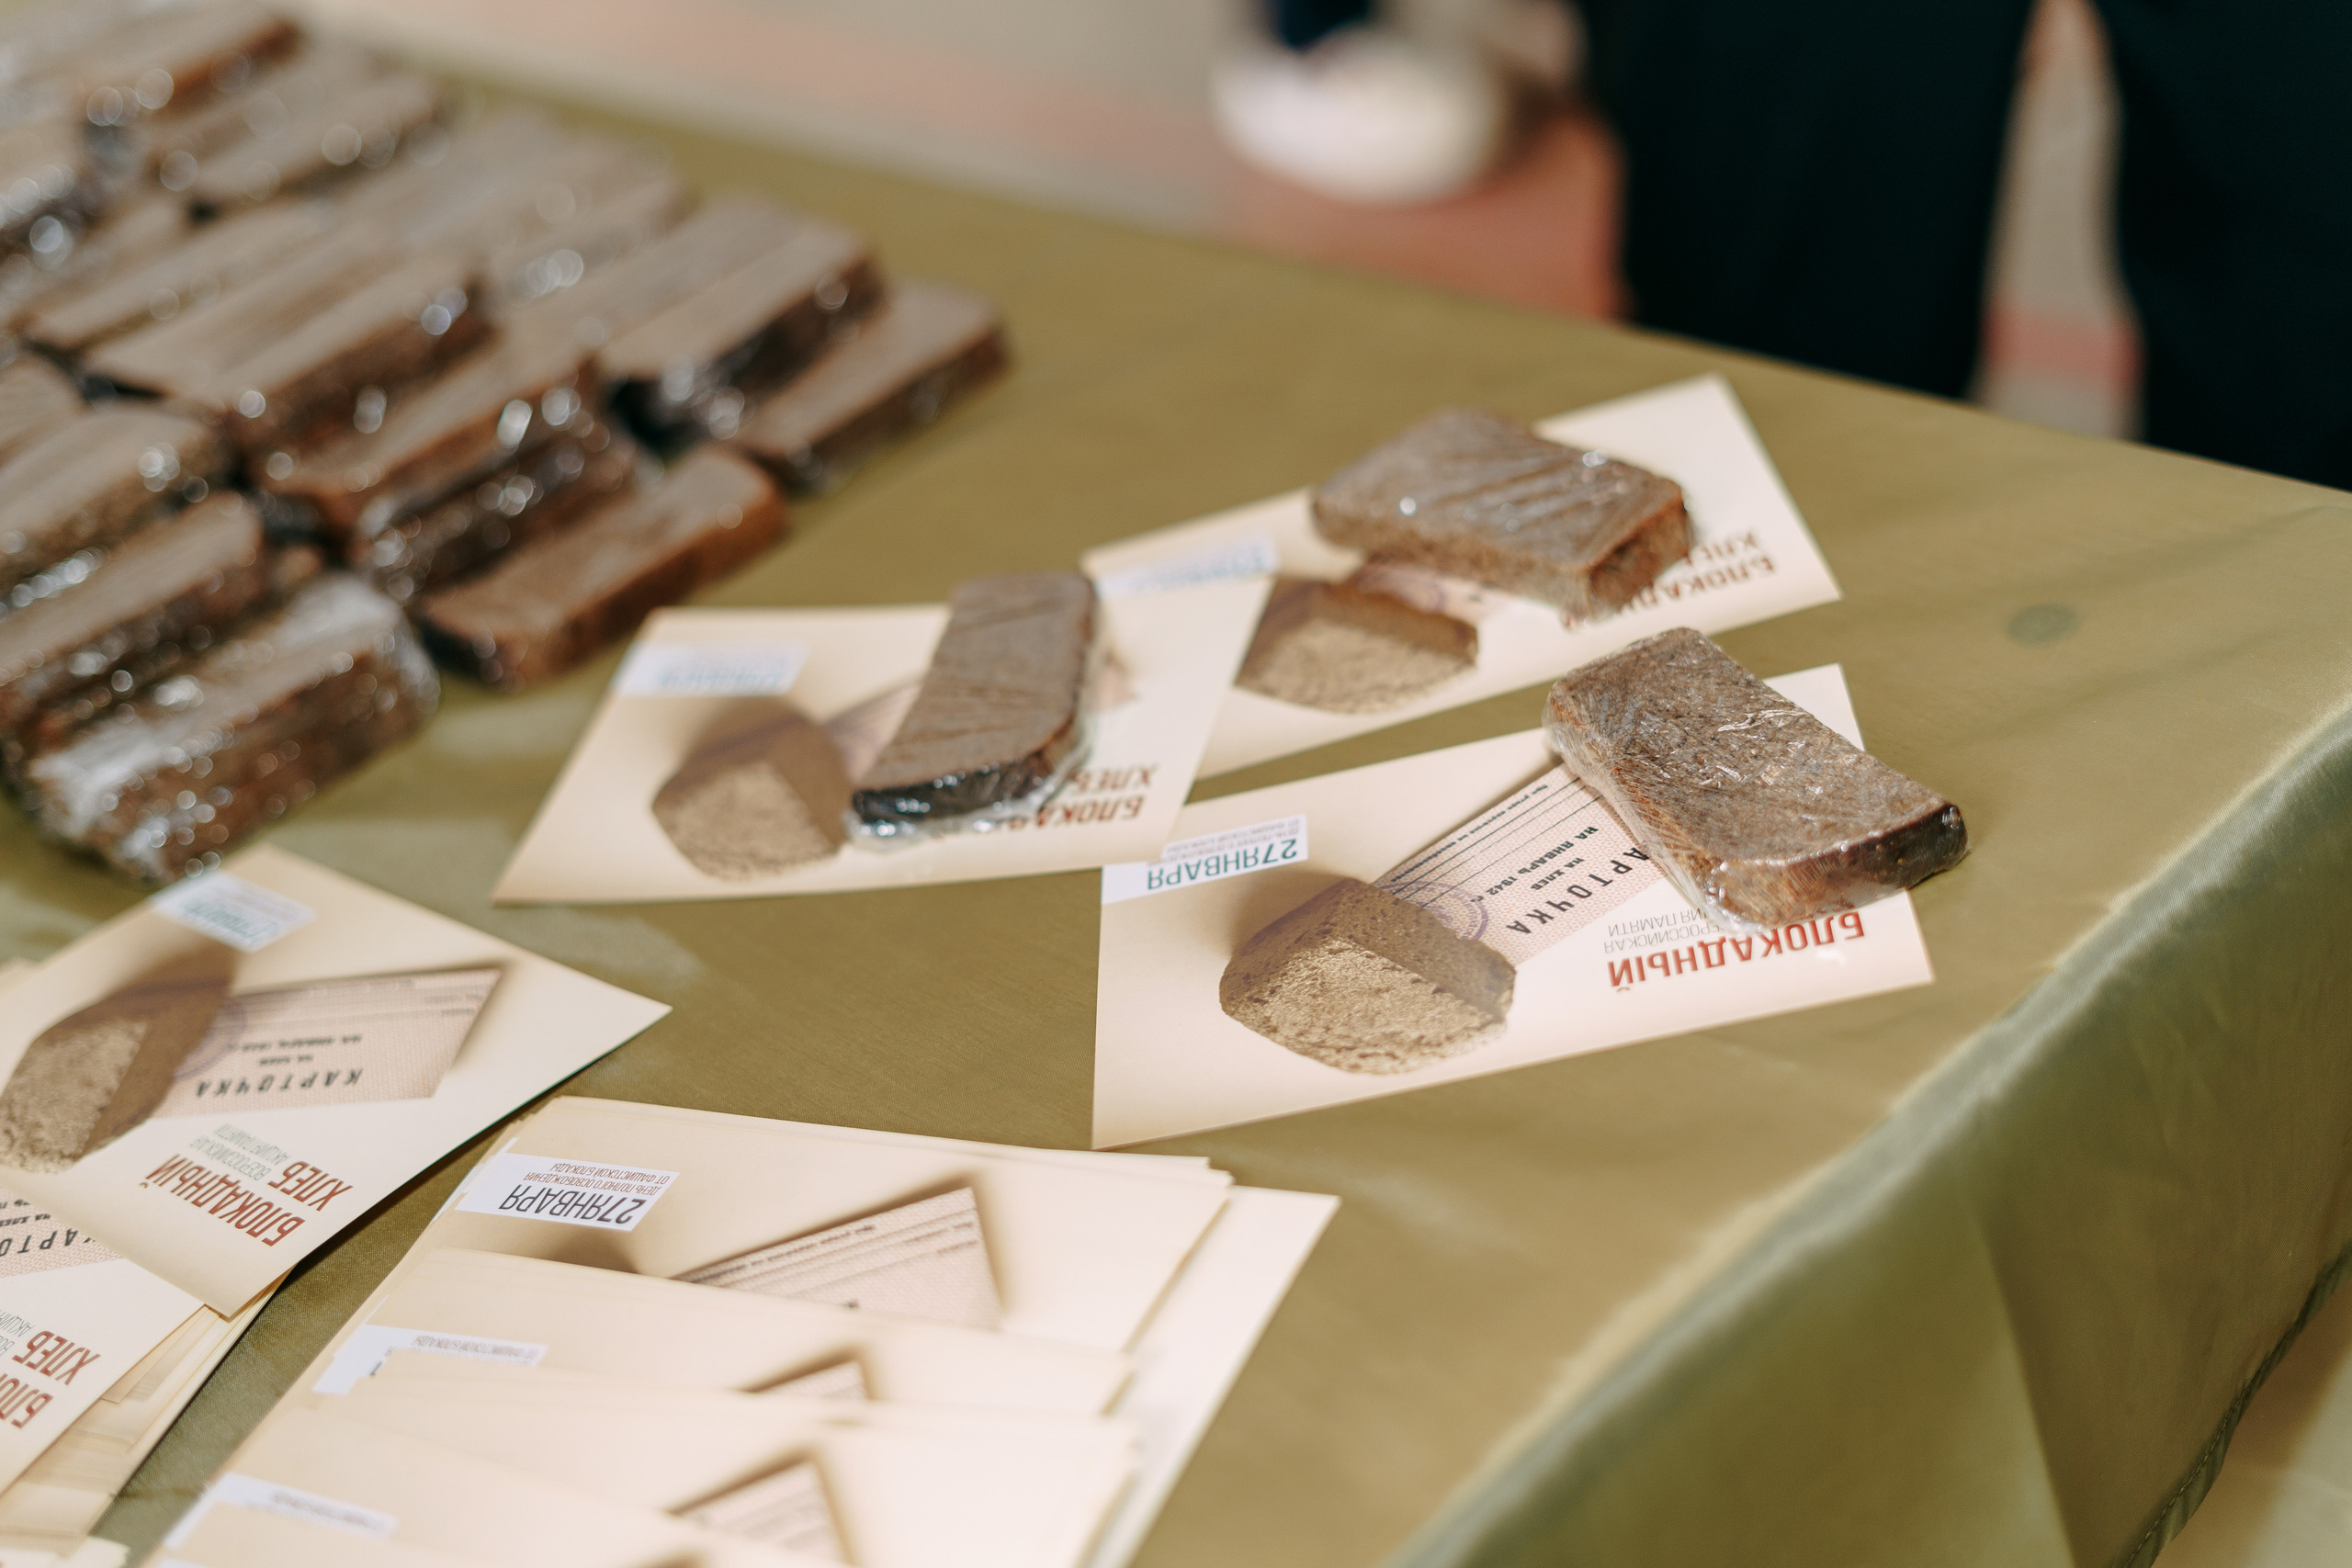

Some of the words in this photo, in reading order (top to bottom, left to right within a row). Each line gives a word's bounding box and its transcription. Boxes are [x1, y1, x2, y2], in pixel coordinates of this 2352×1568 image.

[1575, 826, 1599, 840] НА
[1517, 840, 1575, 876] ЯНВАРЬ
[1565, 856, 1584, 870] НА
[1486, 874, 1517, 897] 1942
[1530, 869, 1563, 891] ХЛЕБ
[1603, 920, 1721, 953] ЕРОССИЙСКАЯ
[1608, 913, 1677, 937] ПАМЯТИ
[1607, 911, 1865, 993] БЛОКАДНЫЙ
[195, 1067, 363, 1099] КАРТОЧКА
[523, 1172, 595, 1189] ОСВОБОЖДЕНИЯ
[549, 1163, 596, 1176] БЛОКАДЫ
[594, 1167, 657, 1183] ФАШИСТСКОЙ
[657, 1176, 671, 1185] ОТ
[267, 1161, 354, 1212] ХЛЕБ
[594, 1179, 636, 1193] ПОЛНОГО
[636, 1184, 662, 1196] ДЕНЬ
[139, 1154, 306, 1247] БЛОКАДНЫЙ
[498, 1184, 647, 1224] 27ЯНВАРЯ
[11, 1331, 101, 1385] ХЛЕБ
